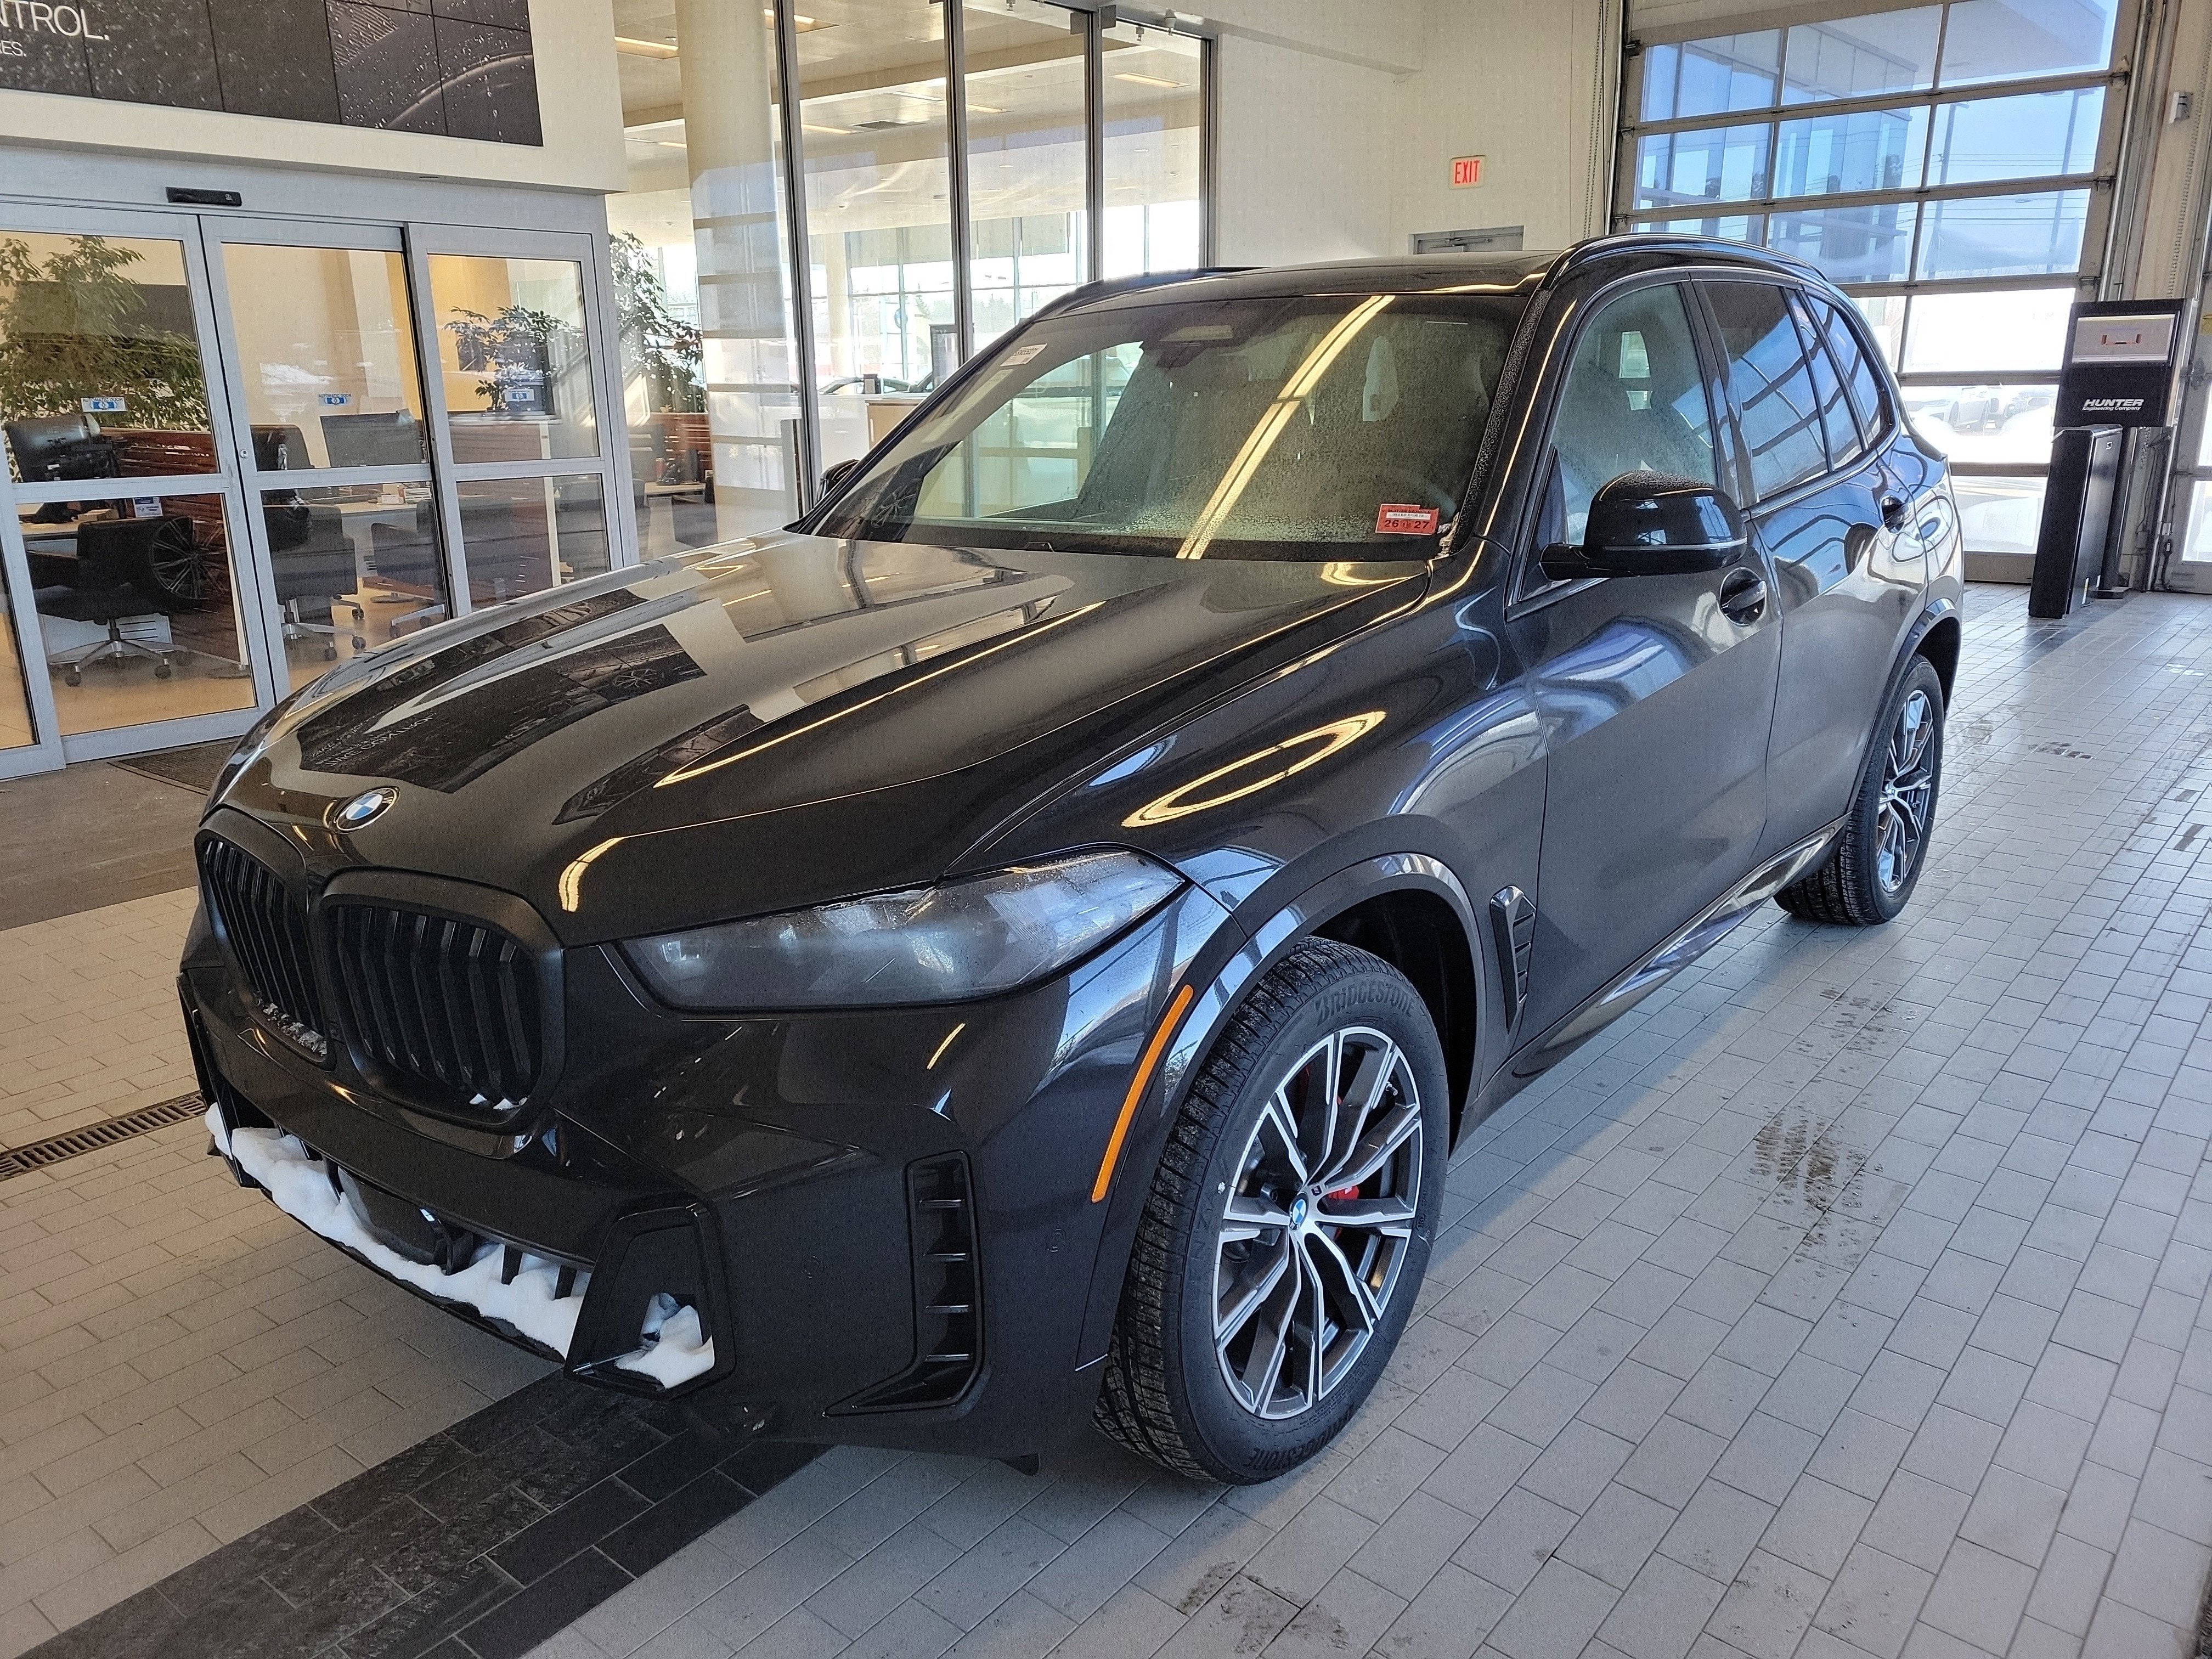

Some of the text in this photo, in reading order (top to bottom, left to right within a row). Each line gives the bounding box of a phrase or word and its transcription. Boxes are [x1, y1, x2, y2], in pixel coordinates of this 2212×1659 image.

[0, 40, 27, 57] ES.
[1455, 160, 1480, 184] EXIT
[1384, 520, 1400, 528] 26
[1413, 521, 1430, 529] 27
[1315, 980, 1415, 1026] BRIDGESTONE
